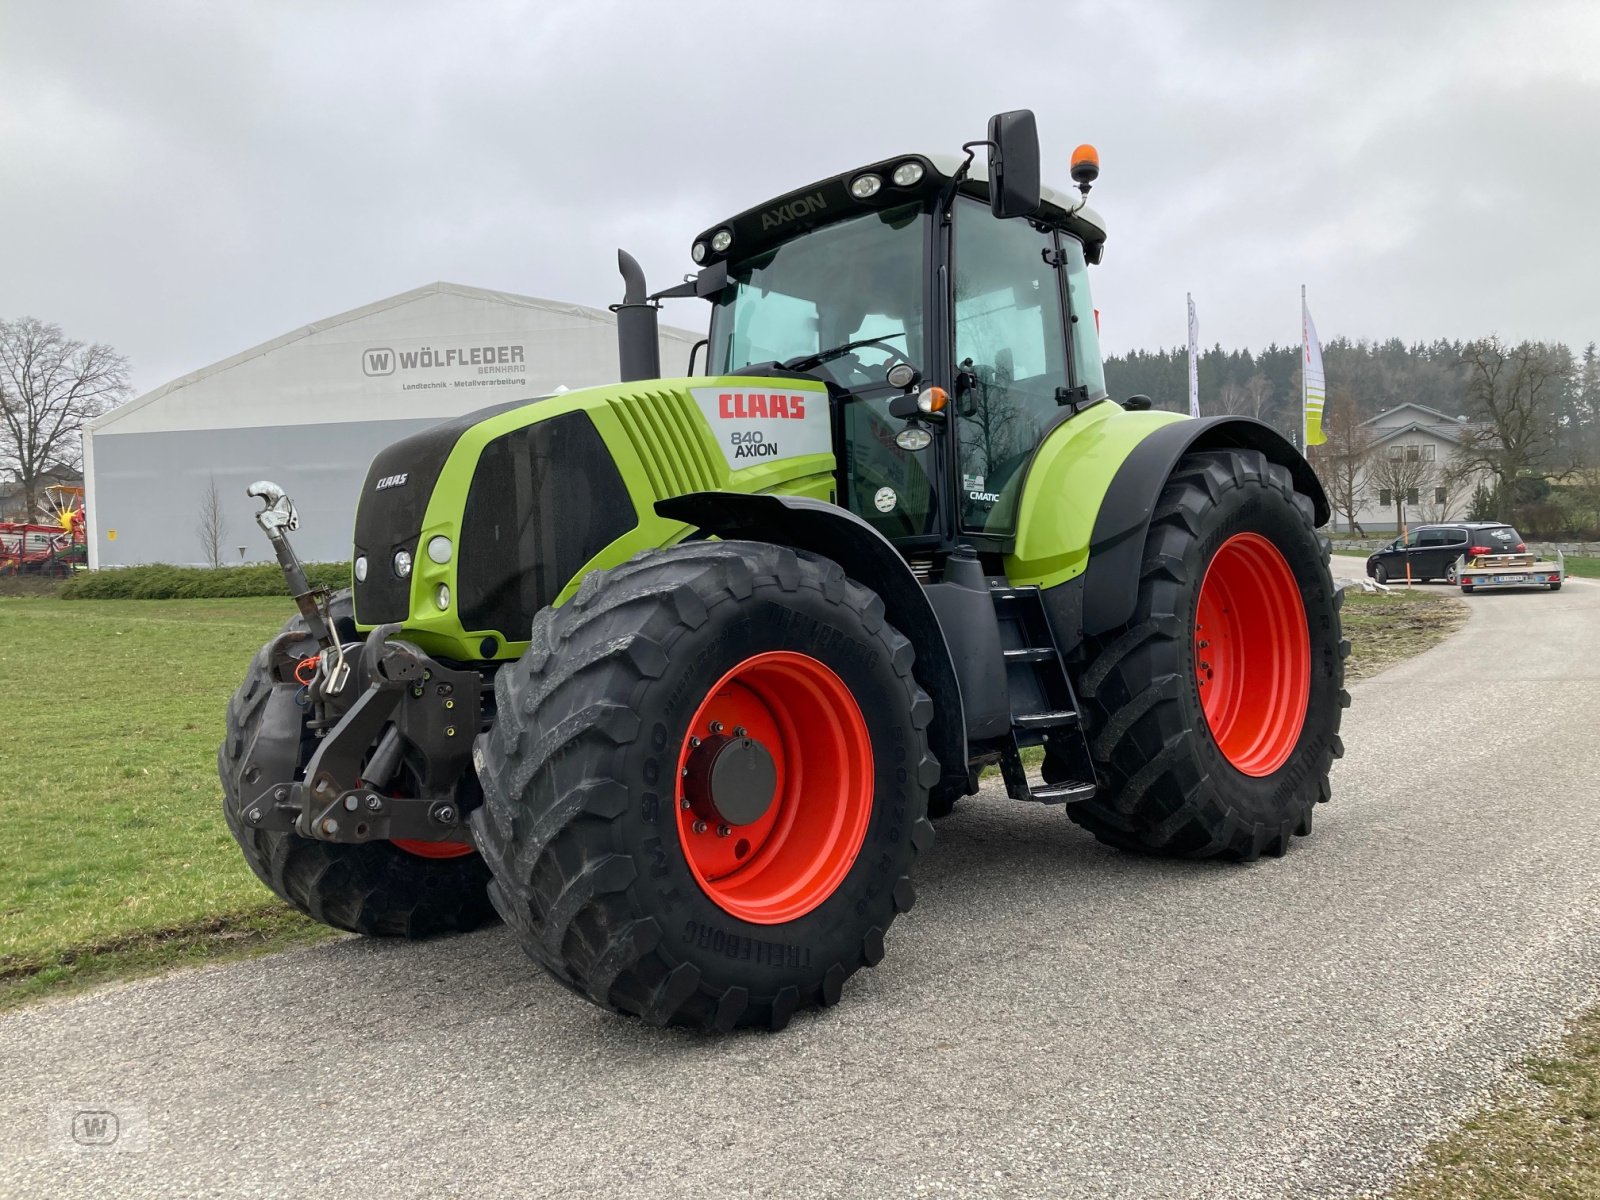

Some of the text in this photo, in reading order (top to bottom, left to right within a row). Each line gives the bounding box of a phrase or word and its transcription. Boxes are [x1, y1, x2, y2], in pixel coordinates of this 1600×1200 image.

[761, 192, 828, 231] AXION
[400, 345, 525, 369] WÖLFLEDER
[402, 382, 447, 391] Landtechnik
[454, 377, 526, 389] Metallverarbeitung
[719, 394, 805, 419] CLAAS
[730, 431, 764, 446] 840
[735, 443, 778, 458] AXION
[376, 473, 408, 490] CLAAS
[970, 491, 1000, 502] CMATIC
[681, 919, 814, 971] TRELLEBORG
